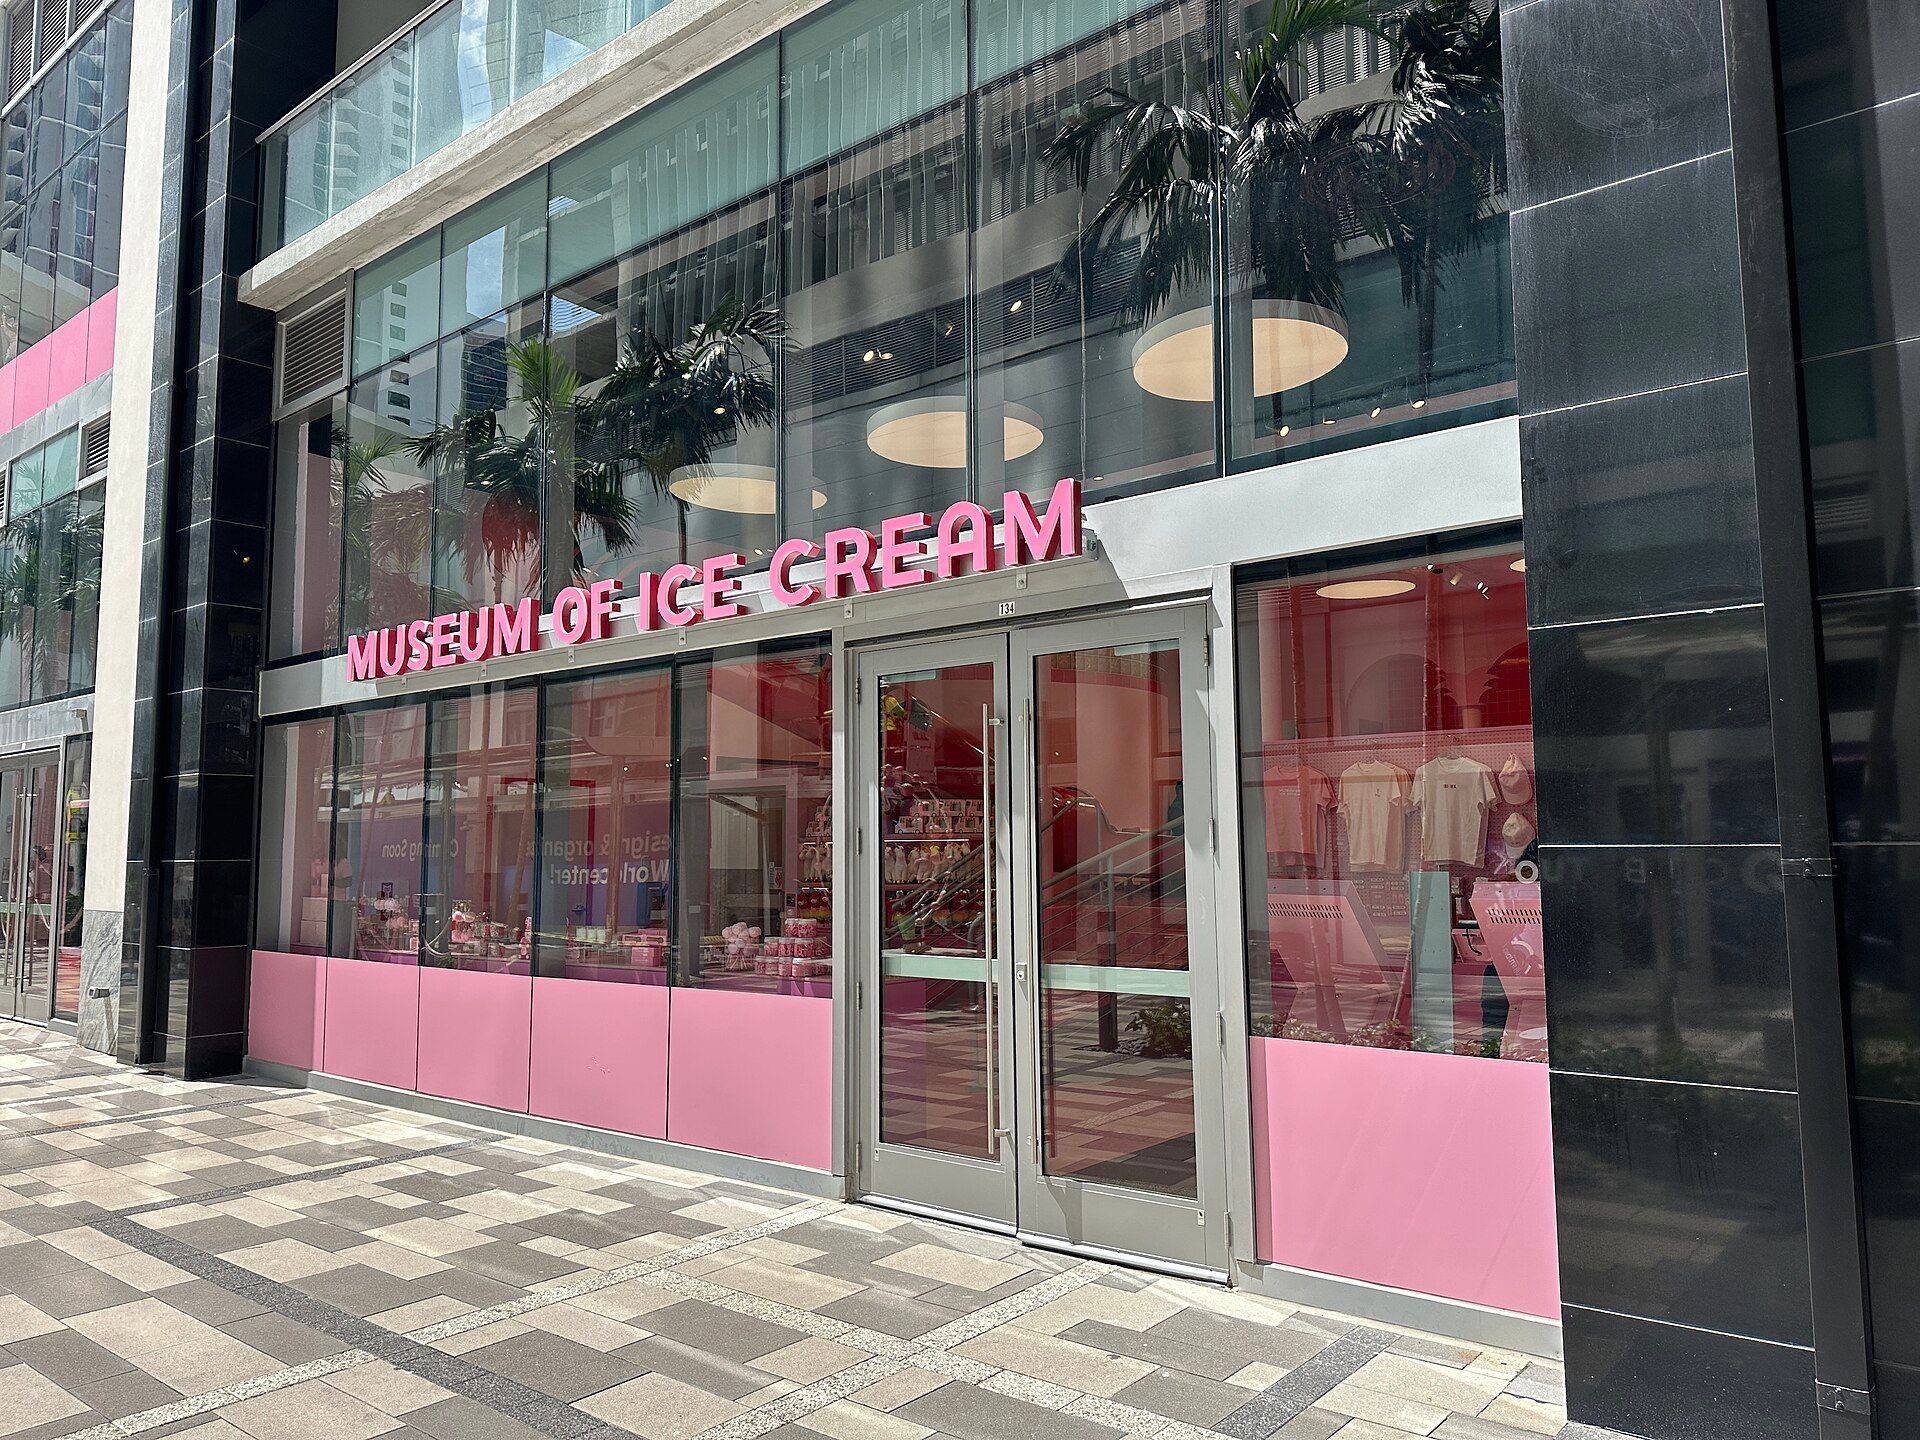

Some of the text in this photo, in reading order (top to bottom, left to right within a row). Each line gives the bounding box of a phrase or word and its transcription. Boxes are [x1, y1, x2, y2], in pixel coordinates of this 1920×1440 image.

[346, 478, 1082, 682] MUSEUM OF ICE CREAM
[1000, 602, 1015, 615] 134
